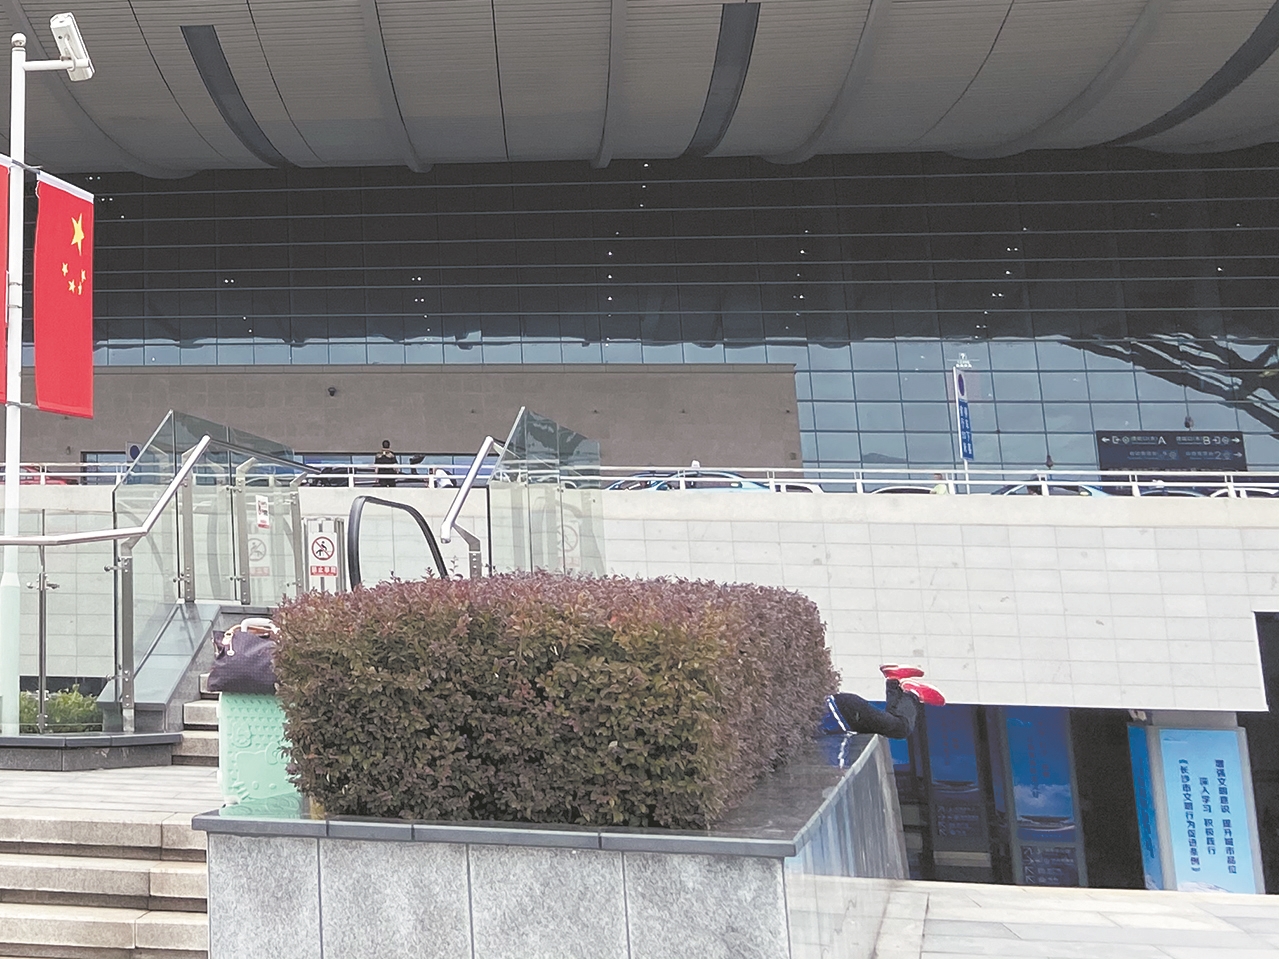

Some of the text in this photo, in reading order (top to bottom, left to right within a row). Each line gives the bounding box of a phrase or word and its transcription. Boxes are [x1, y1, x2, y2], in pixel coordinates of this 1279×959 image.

[1199, 777, 1212, 813] 深入学习
[1215, 759, 1237, 874] 增强文明意识 提升城市品位
